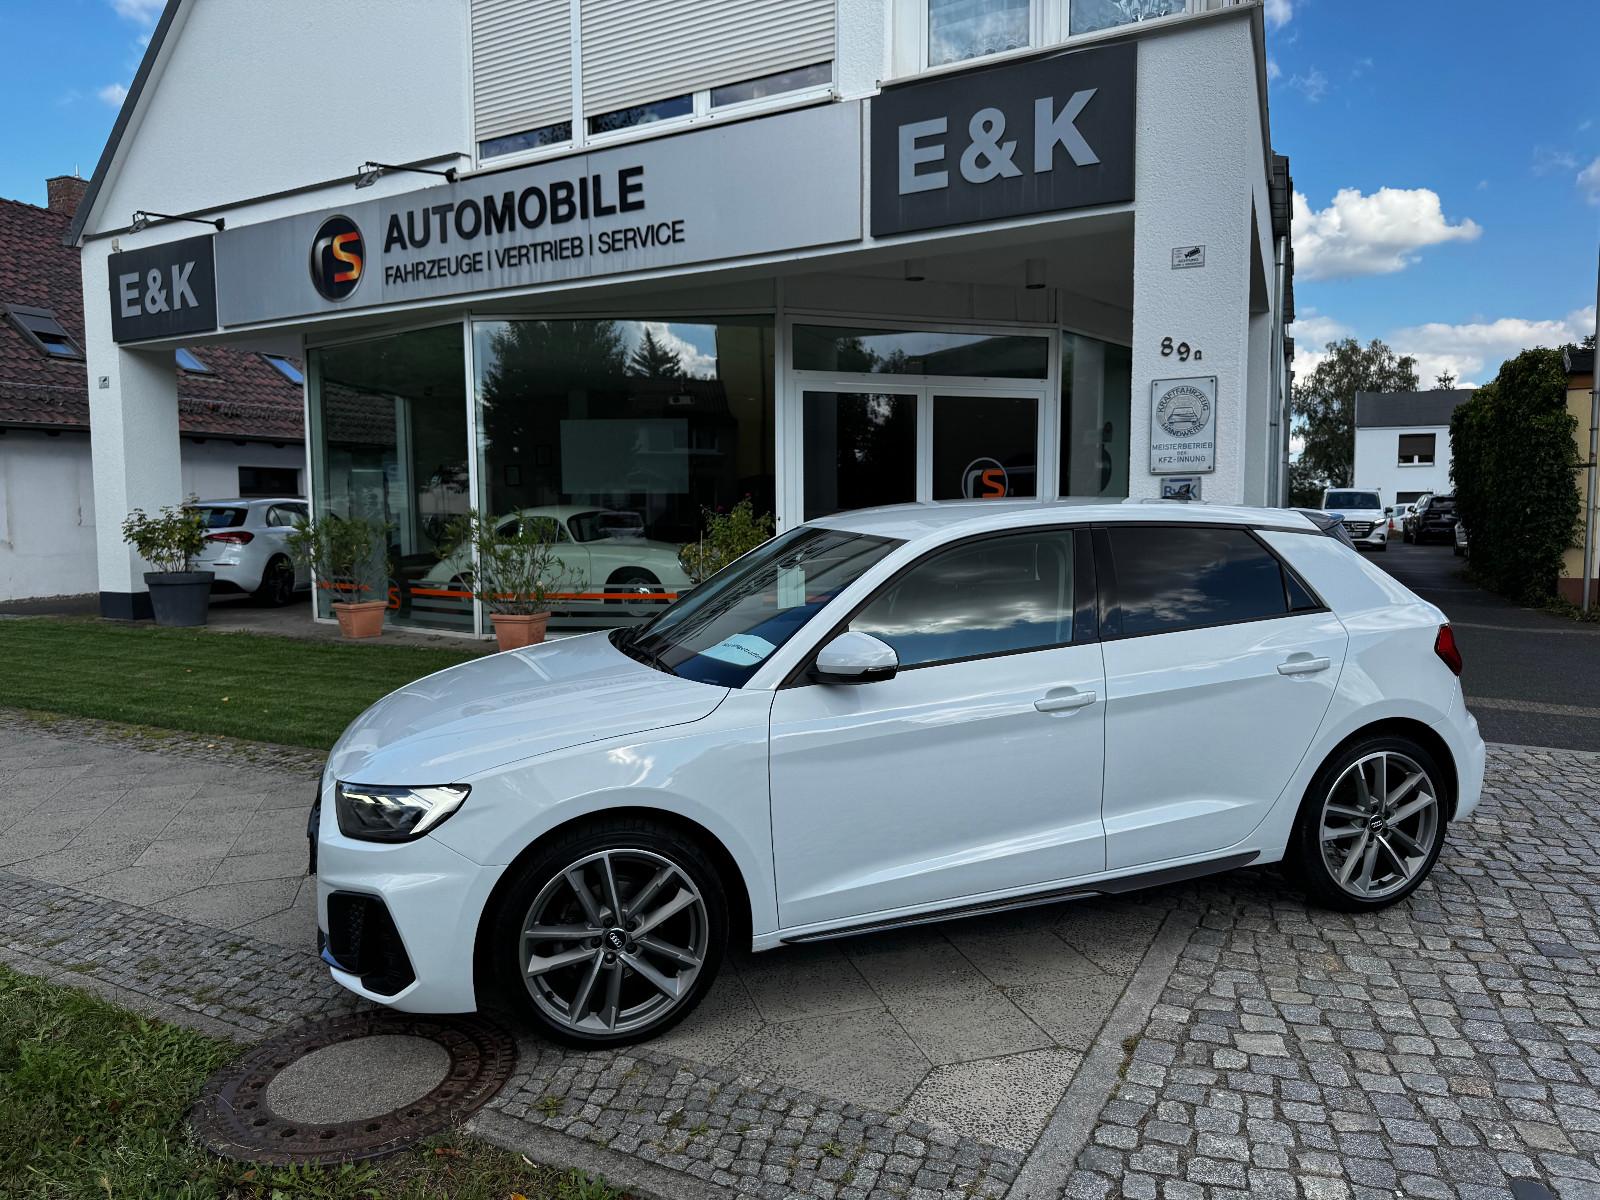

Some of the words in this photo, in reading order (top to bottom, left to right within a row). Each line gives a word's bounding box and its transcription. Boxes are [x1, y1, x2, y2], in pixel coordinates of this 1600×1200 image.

[898, 88, 1101, 196] E&K
[383, 165, 645, 253] AUTOMOBILE
[385, 251, 483, 286] FAHRZEUGE
[494, 236, 584, 268] VERTRIEB
[597, 219, 686, 254] SERVICE
[119, 261, 200, 319] E&K
[1157, 387, 1209, 413] KRAFTFAHRZEUG
[1152, 442, 1213, 451] MEISTERBETRIEB
[1161, 421, 1204, 437] HANDWERK
[1158, 455, 1206, 463] KFZ-INNUNG
